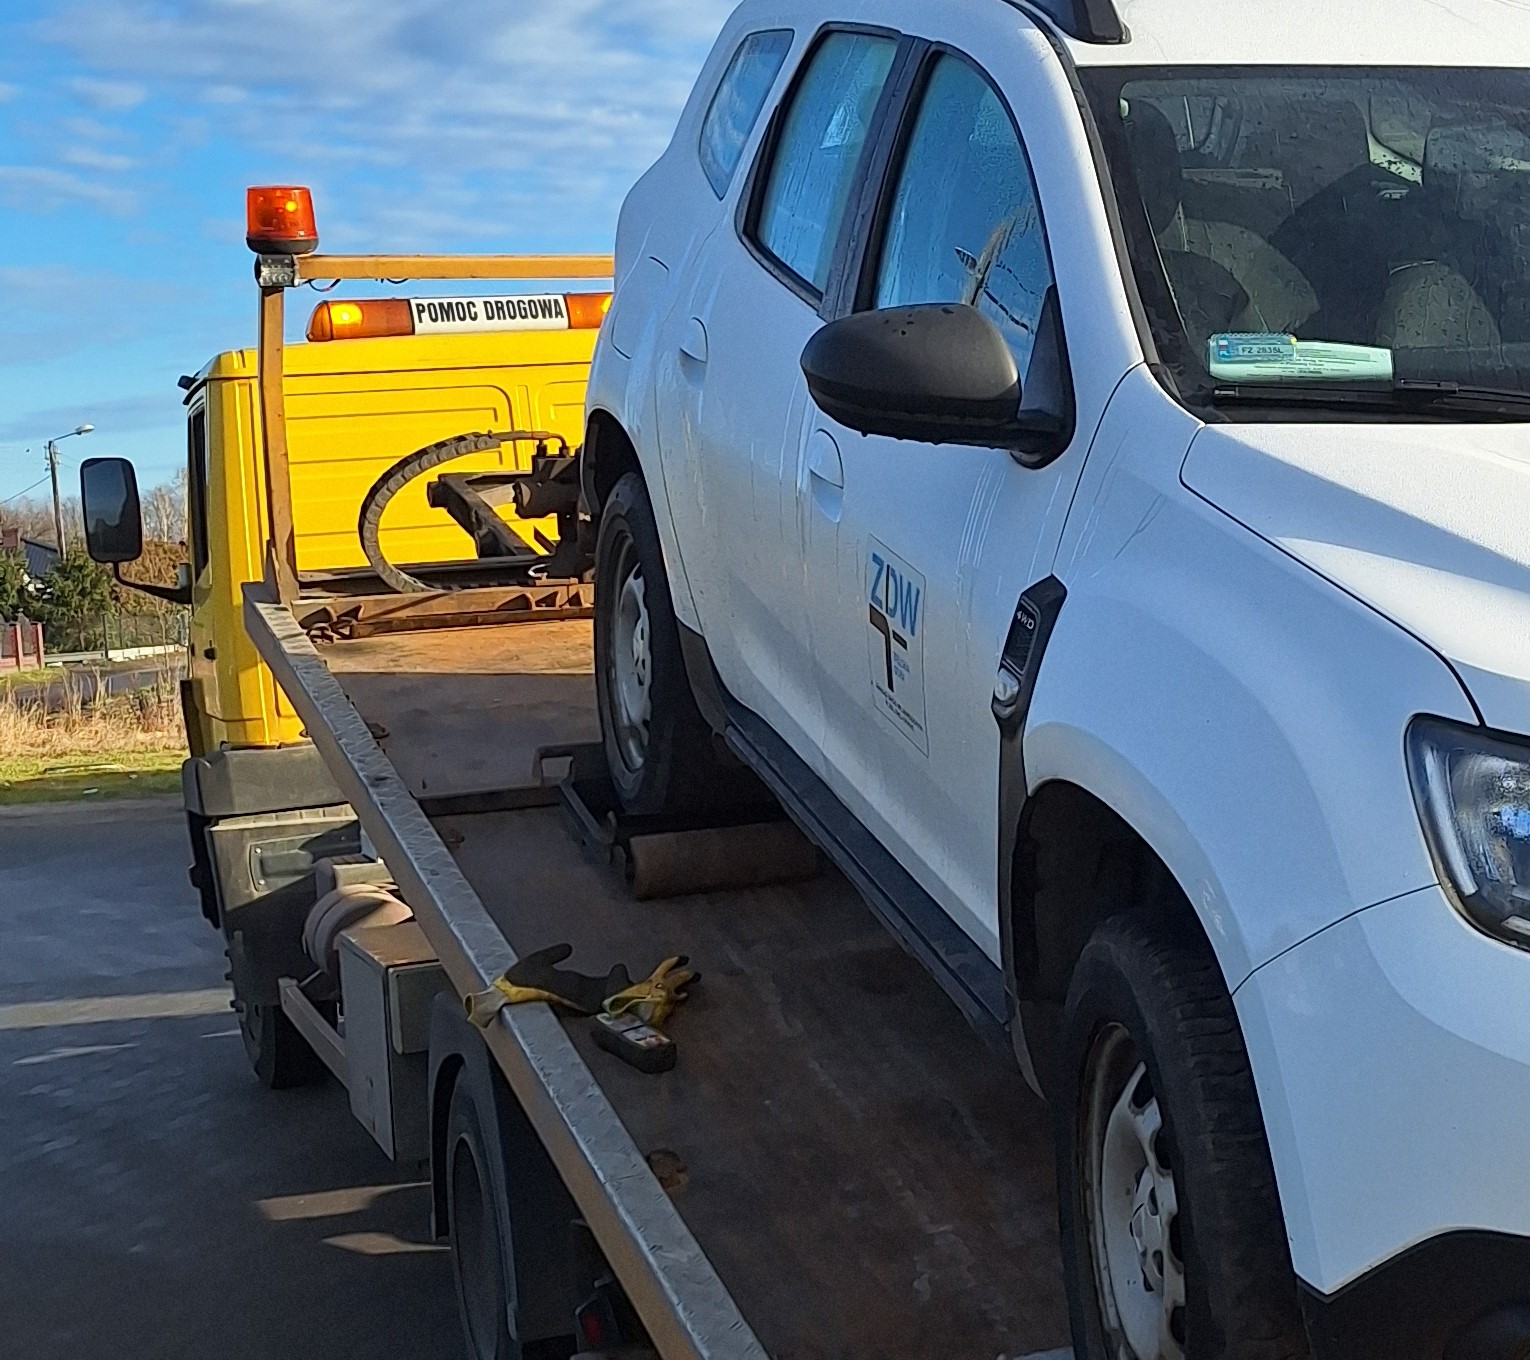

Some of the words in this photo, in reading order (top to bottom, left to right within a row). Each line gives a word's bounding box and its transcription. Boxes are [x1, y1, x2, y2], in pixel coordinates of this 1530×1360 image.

[415, 300, 479, 324] POMOC
[482, 298, 565, 321] DROGOWA
[871, 551, 921, 638] ZDW
[1016, 610, 1035, 630] 4WD
